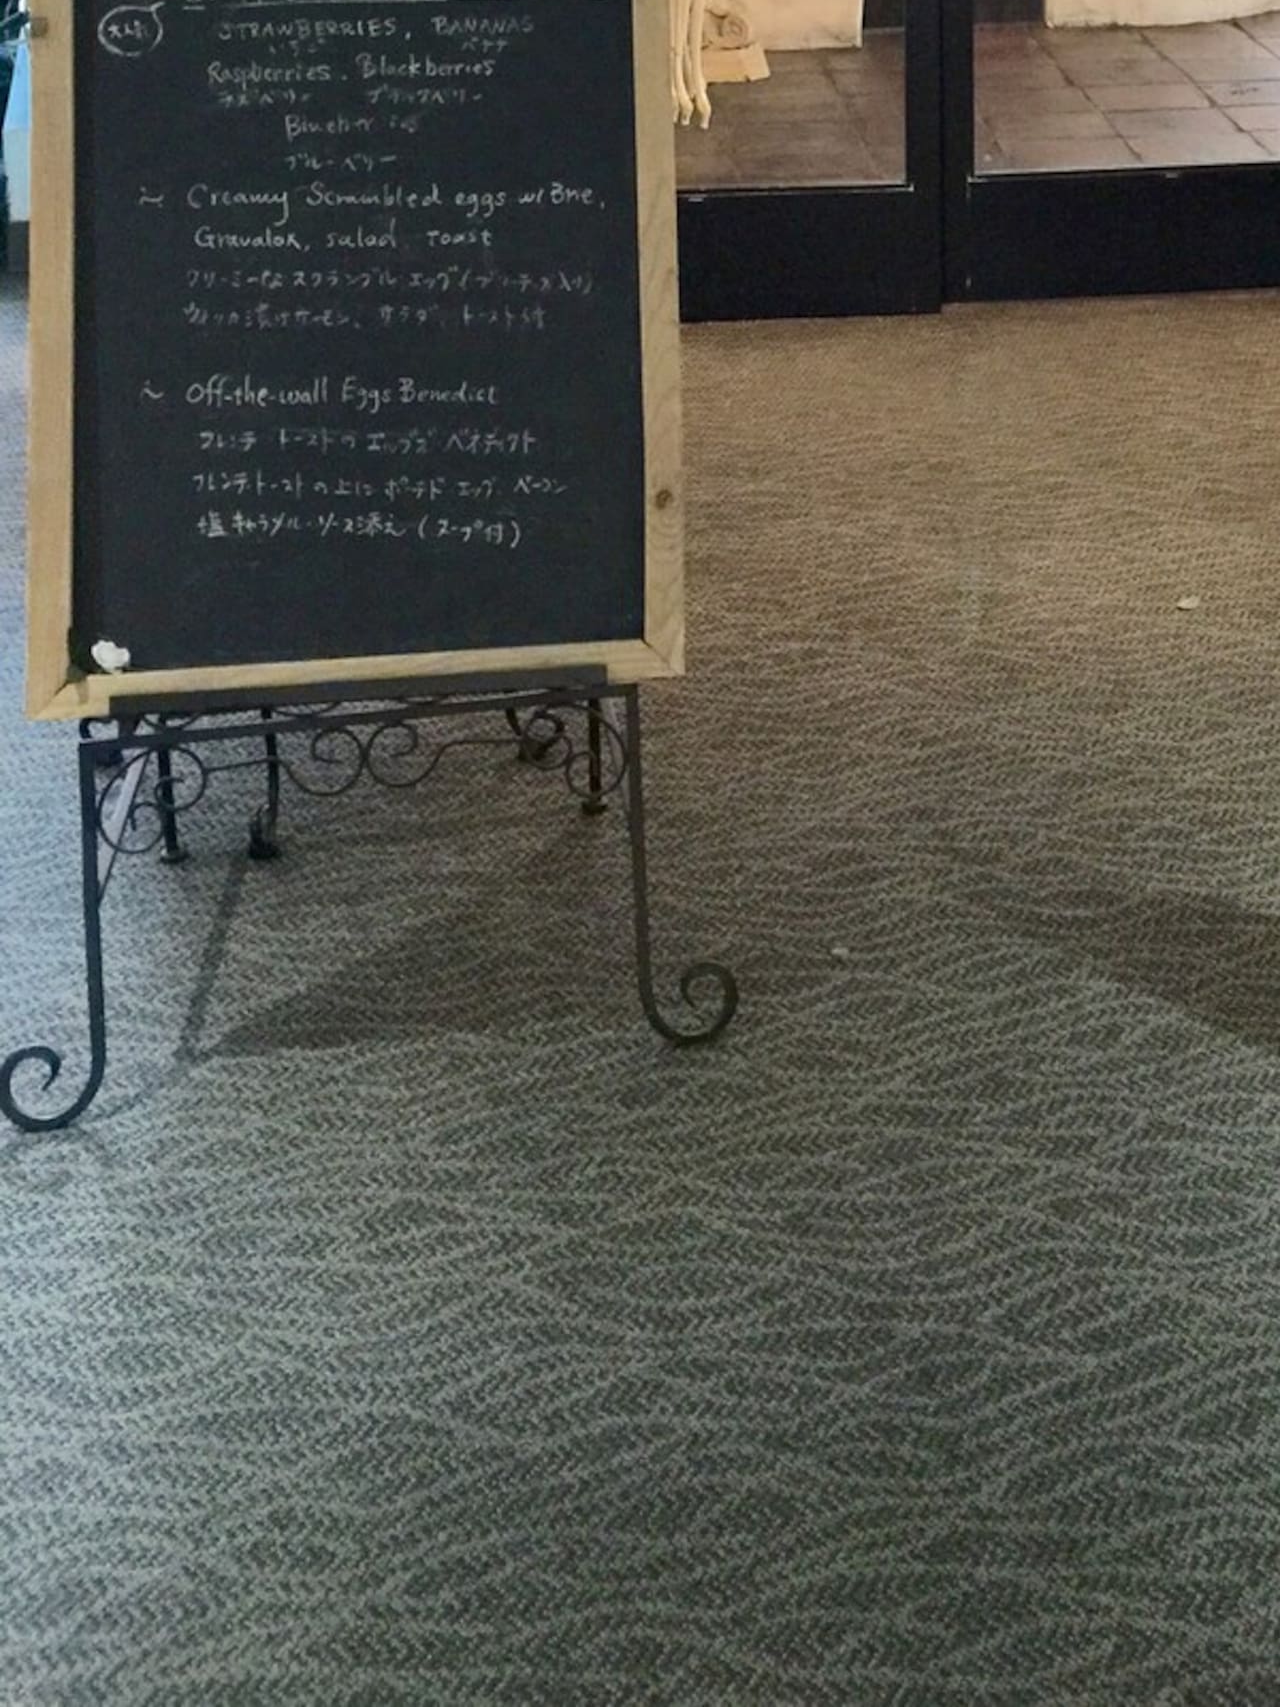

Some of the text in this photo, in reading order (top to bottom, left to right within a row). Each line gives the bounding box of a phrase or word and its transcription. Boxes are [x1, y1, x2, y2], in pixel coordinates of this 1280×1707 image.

[431, 15, 534, 36] BANANAS
[355, 53, 496, 79] Blackberries
[187, 183, 289, 226] Creamy
[306, 181, 442, 208] Scrambled
[455, 191, 506, 218] eggs
[342, 376, 391, 413] Eggs
